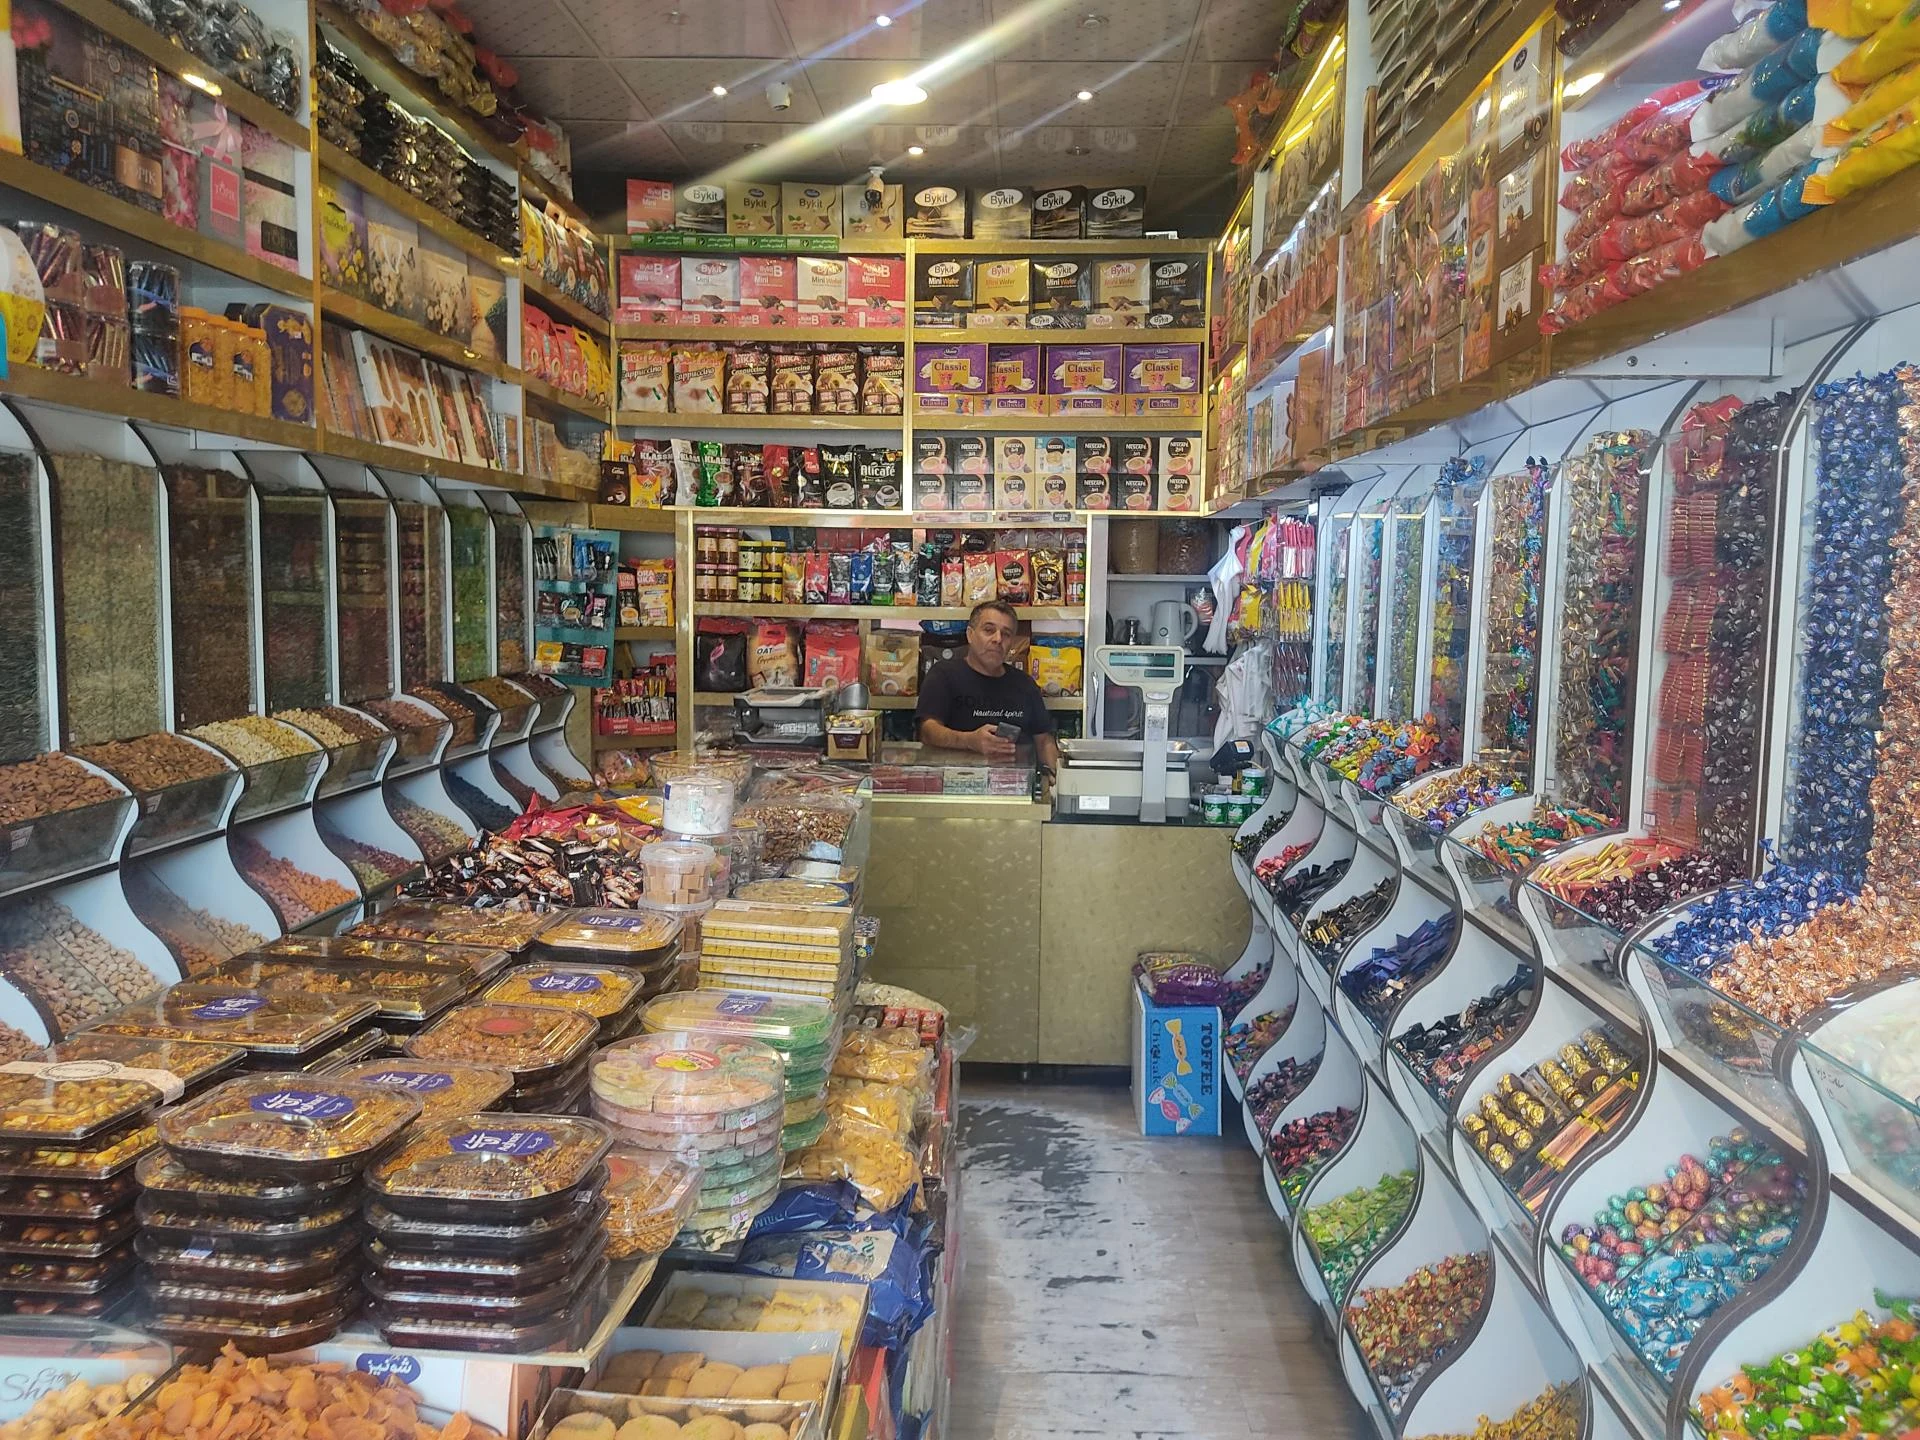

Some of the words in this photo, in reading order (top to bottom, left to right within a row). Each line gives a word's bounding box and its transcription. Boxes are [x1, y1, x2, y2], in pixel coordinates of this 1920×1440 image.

[693, 190, 718, 202] Bykit
[924, 193, 949, 205] Bykit
[990, 194, 1015, 206] Bykit
[1042, 194, 1065, 207] Bykit
[1101, 194, 1126, 207] Bykit
[743, 197, 768, 209] Bykit
[799, 198, 823, 209] Bykit
[701, 264, 723, 275] Bykit
[934, 265, 954, 275] Bykit
[991, 266, 1011, 276] Bykit
[1053, 265, 1073, 276] Bykit
[1110, 266, 1131, 276] Bykit
[1161, 266, 1182, 276] Bykit
[862, 275, 876, 284] Mini
[928, 277, 942, 285] Mini
[1046, 277, 1060, 286] Mini
[735, 356, 755, 364] BIKA
[780, 355, 800, 364] BIKA
[823, 353, 844, 363] BIKA
[871, 360, 891, 368] BIKA
[934, 362, 967, 371] Classic
[1067, 364, 1101, 373] Classic
[1144, 362, 1179, 372] Classic
[622, 365, 662, 380] Cappuccino
[674, 367, 715, 381] Cappuccino
[921, 399, 948, 407] Classic
[998, 400, 1024, 408] Classic
[1150, 400, 1178, 408] Classic
[756, 647, 773, 655] OAT
[972, 708, 1004, 717] Nautical
[1004, 709, 1024, 719] spirit
[1200, 1022, 1213, 1096] TOFFEE
